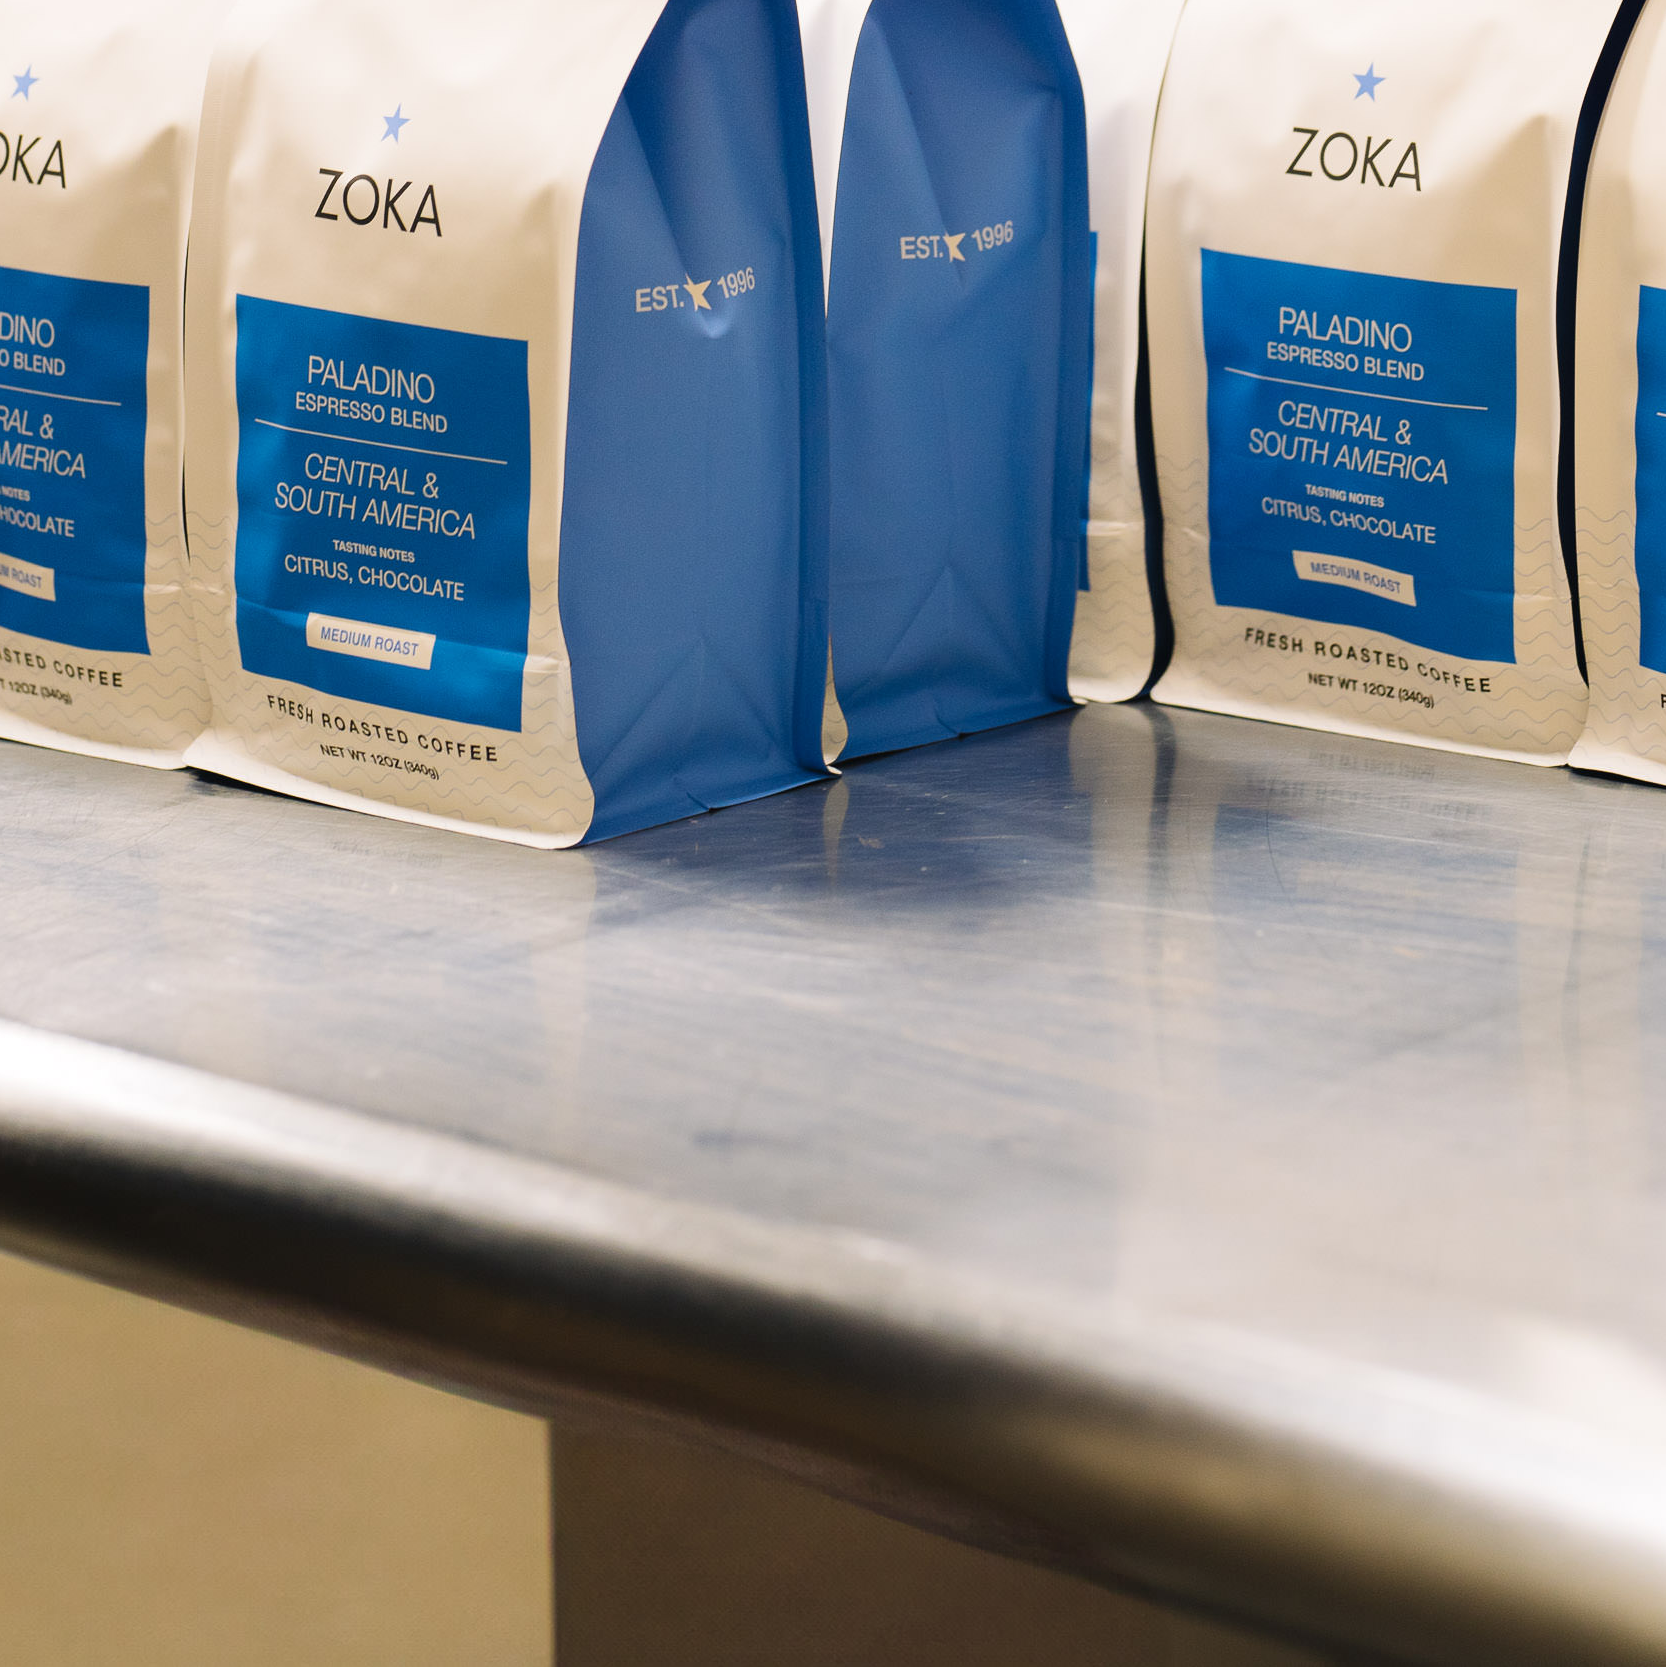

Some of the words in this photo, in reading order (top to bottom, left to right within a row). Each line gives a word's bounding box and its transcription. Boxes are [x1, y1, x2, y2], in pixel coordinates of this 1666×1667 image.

[1285, 126, 1422, 192] ZOKA
[315, 168, 443, 237] ZOKA
[900, 235, 944, 260] EST.
[971, 219, 1014, 252] 1996
[635, 284, 684, 313] EST.
[716, 266, 756, 299] 1996
[1279, 306, 1413, 353] PALADINO
[13, 354, 65, 376] BLEND
[308, 355, 435, 404] PALADINO
[1267, 341, 1359, 372] ESPRESSO
[1364, 355, 1425, 381] BLEND
[39, 414, 54, 440] &
[295, 391, 385, 423] ESPRESSO
[391, 407, 448, 434] BLEND
[1278, 400, 1388, 442] CENTRAL
[1395, 419, 1413, 445] &
[305, 453, 415, 496] CENTRAL
[422, 472, 440, 499] &
[1249, 428, 1329, 466] SOUTH
[1333, 444, 1449, 485] AMERICA
[1, 484, 30, 502] NOTES
[274, 482, 357, 521] SOUTH
[362, 498, 476, 540] AMERICA
[1305, 484, 1347, 503] TASTING
[1348, 491, 1385, 509] NOTES
[1261, 496, 1327, 527] CITRUS,
[1330, 510, 1436, 544] CHOCOLATE
[332, 539, 377, 557] TASTING
[379, 545, 416, 564] NOTES
[11, 567, 42, 589] ROAST
[284, 554, 353, 584] CITRUS,
[358, 566, 465, 602] CHOCOLATE
[1311, 562, 1361, 582] MEDIUM
[1364, 572, 1401, 594] ROAST
[320, 626, 372, 649] MEDIUM
[375, 636, 419, 657] ROAST
[1244, 627, 1303, 654] FRESH
[1315, 642, 1409, 672] ROASTED
[1417, 663, 1491, 693] COFFEE
[53, 660, 123, 688] COFFEE
[1308, 672, 1335, 687] NET
[1338, 676, 1359, 692] WT
[1398, 687, 1435, 709] (340g)
[267, 694, 314, 724] FRESH
[322, 712, 409, 745] ROASTED
[418, 735, 498, 763] COFFEE
[320, 743, 345, 758] NET
[347, 749, 367, 763] WT
[404, 759, 440, 781] (340g)
